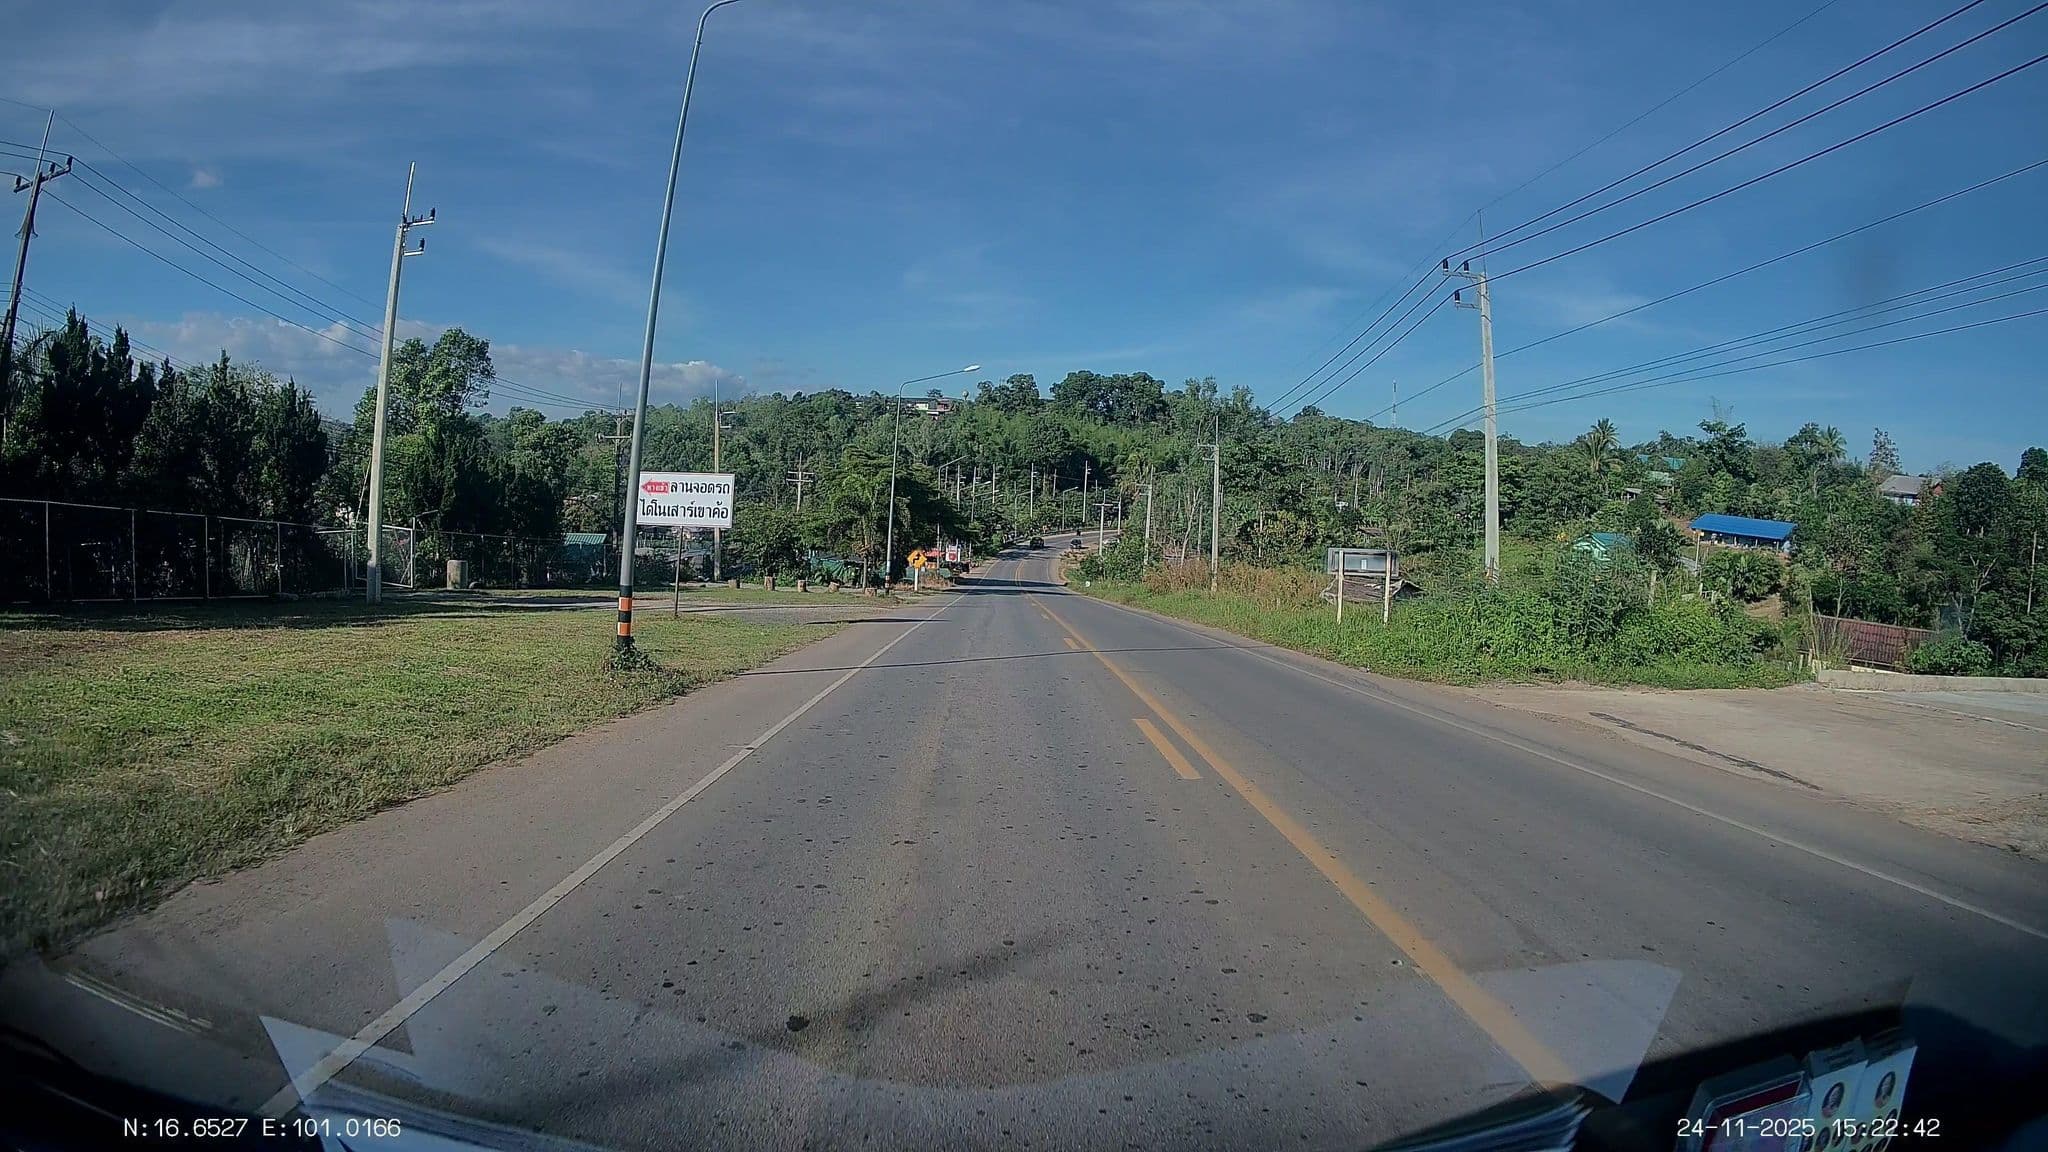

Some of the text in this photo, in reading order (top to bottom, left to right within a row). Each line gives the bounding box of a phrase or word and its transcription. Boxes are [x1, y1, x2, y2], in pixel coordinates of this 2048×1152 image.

[670, 481, 730, 494] ลานจอดรถ
[639, 498, 729, 519] ไดโนเสาร์เขาค้อ
